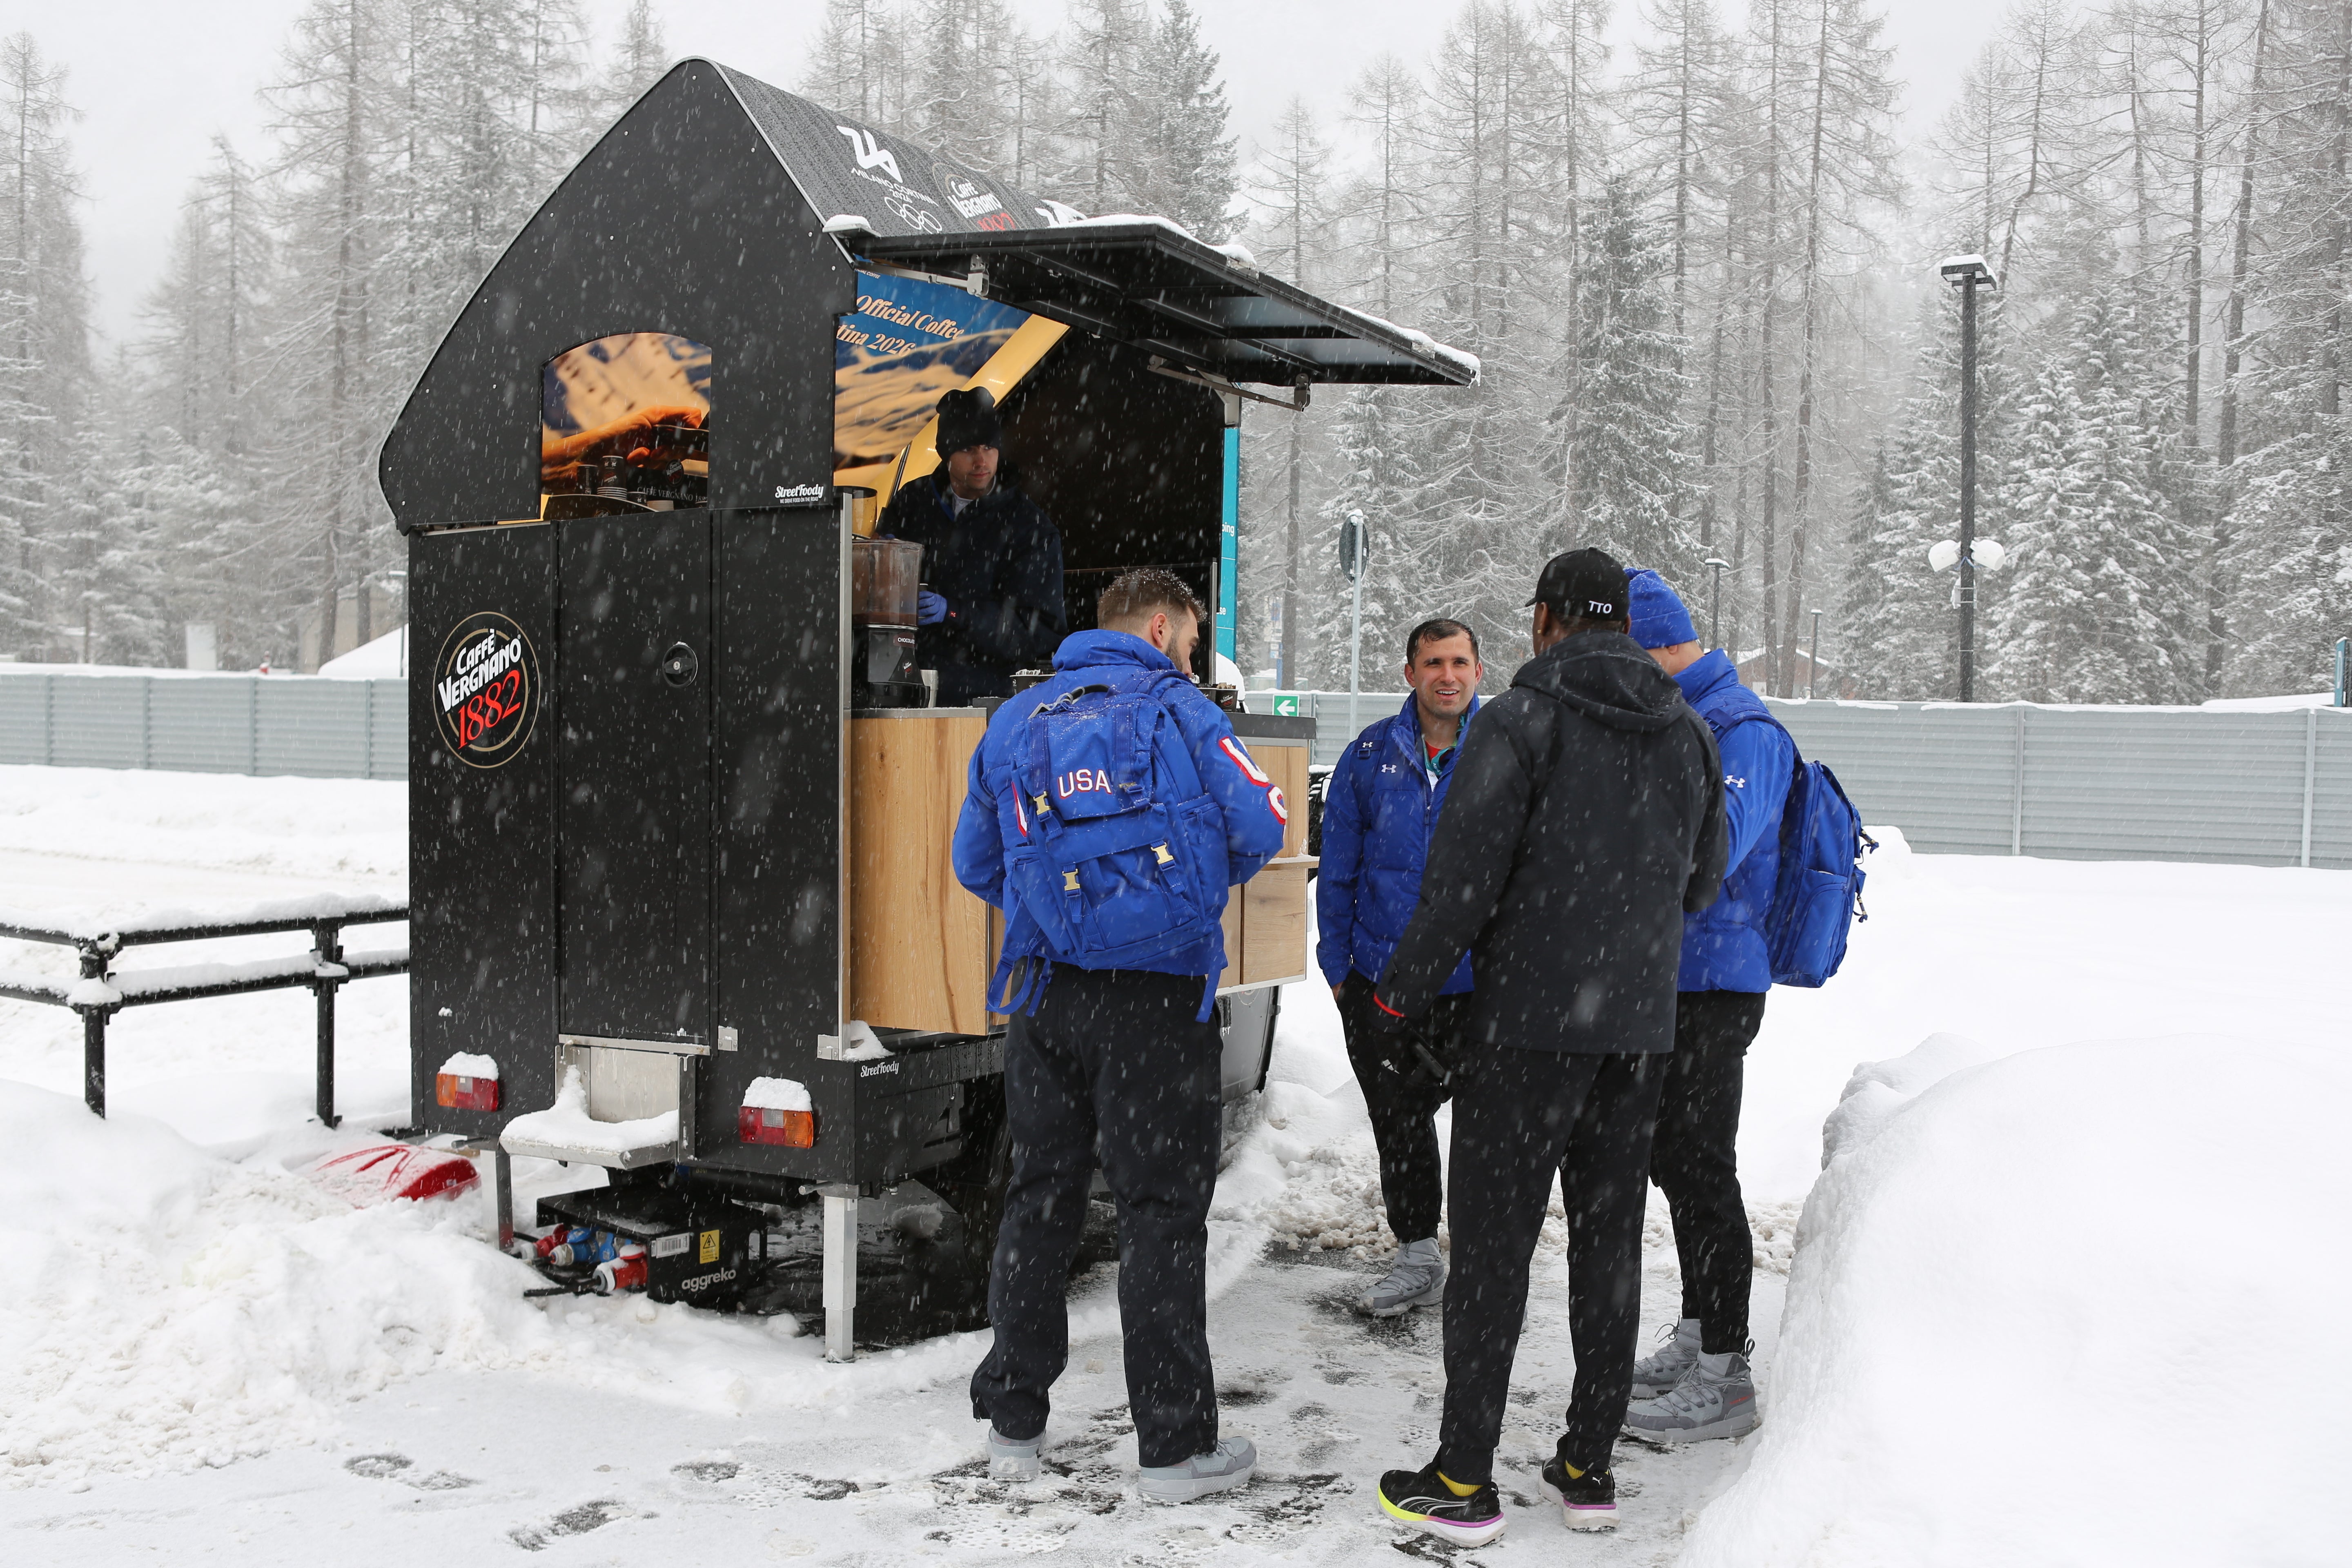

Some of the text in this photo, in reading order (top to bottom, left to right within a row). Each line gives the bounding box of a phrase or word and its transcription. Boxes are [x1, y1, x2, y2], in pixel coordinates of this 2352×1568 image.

[851, 167, 939, 207] MILANO CORTINA
[889, 188, 913, 204] 2026
[951, 178, 978, 198] CAFFÈ
[947, 193, 1002, 218] VERGNANO
[866, 271, 881, 279] COFFEE
[856, 295, 965, 340] Official Coffee
[866, 333, 916, 357] 2026
[658, 490, 693, 501] VERGNANO
[775, 484, 824, 499] StreetFoody
[1216, 607, 1226, 615] se
[1588, 600, 1612, 614] TTO
[456, 628, 495, 675] CAFFÈ
[438, 638, 522, 712] VERGNANO
[458, 670, 521, 749] 1882
[1057, 768, 1112, 800] USA
[860, 1060, 899, 1078] StreetFoody
[682, 1267, 736, 1292] aggreko
